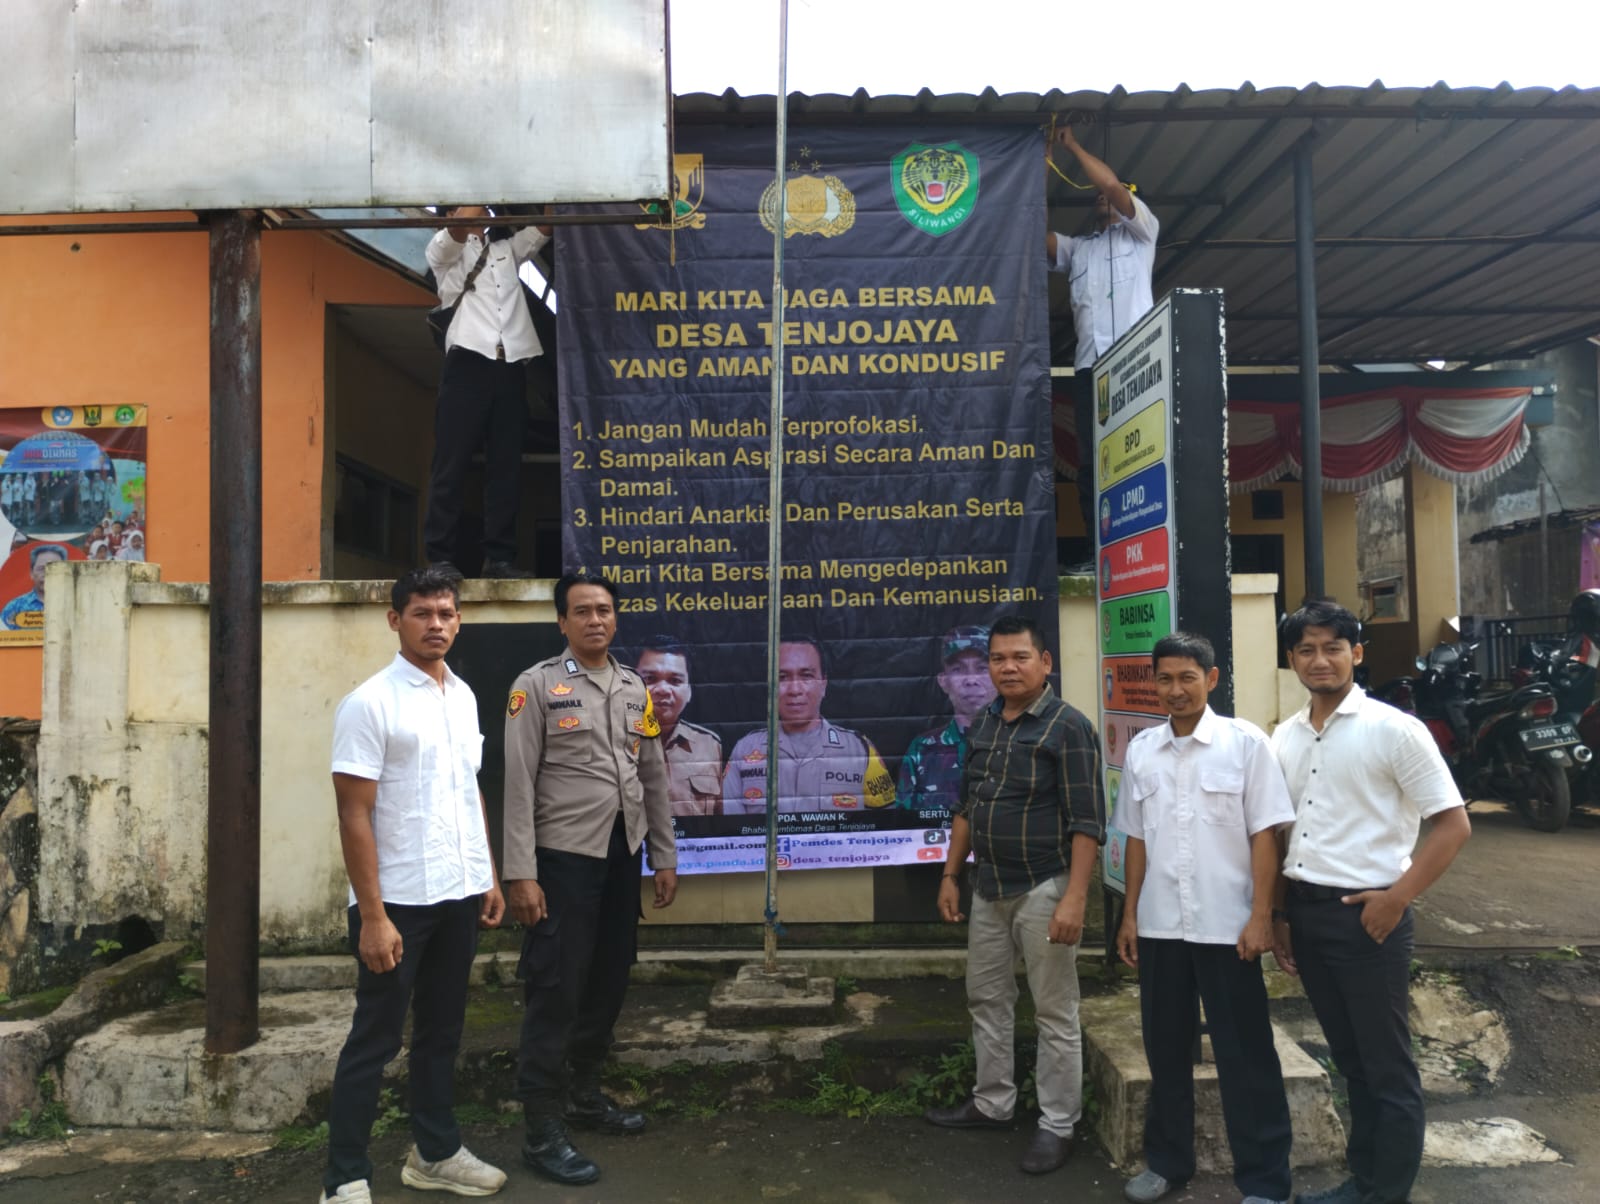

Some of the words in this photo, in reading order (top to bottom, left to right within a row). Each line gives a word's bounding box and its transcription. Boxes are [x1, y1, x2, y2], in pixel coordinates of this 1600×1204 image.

[908, 207, 966, 228] SILIWANGI
[615, 290, 687, 312] MARI
[697, 289, 765, 310] KITA
[858, 285, 997, 307] BERSAMA
[656, 322, 748, 348] DESA
[757, 319, 959, 346] TENJOJAYA
[609, 357, 688, 379] YANG
[697, 355, 773, 377] AMAN
[791, 354, 849, 376] DAN
[859, 350, 1006, 374] KONDUSIF
[1111, 386, 1126, 417] DESA
[572, 421, 592, 440] 1.
[598, 420, 682, 443] Jangan
[690, 418, 767, 439] Mudah
[1124, 428, 1140, 454] BPD
[572, 451, 592, 469] 2.
[599, 447, 726, 472] Sampaikan
[733, 444, 827, 470] Asprasi
[834, 443, 913, 464] Secara
[919, 442, 985, 462] Aman
[992, 440, 1036, 459] Dan
[600, 477, 679, 497] Damai.
[1122, 484, 1145, 512] LPMD
[573, 508, 593, 527] 3.
[601, 506, 683, 526] Hindari
[785, 502, 830, 522] Dan
[837, 500, 958, 520] Perusakan
[965, 497, 1024, 517] Serta
[601, 534, 737, 559] Penjarahan.
[1126, 541, 1143, 565] PKK
[602, 564, 651, 584] Mari
[659, 563, 704, 582] Kita
[820, 555, 1008, 582] Mengedepankan
[618, 598, 658, 613] zas
[665, 592, 823, 612] Kekeluaraan
[831, 588, 875, 608] Dan
[883, 584, 1044, 606] Kemanusiaan.
[1119, 603, 1156, 627] BABINSA
[825, 771, 863, 784] POLRI
[801, 812, 836, 822] WAWAN
[791, 838, 843, 848] Pemdes
[846, 835, 913, 846] Tenjojaya
